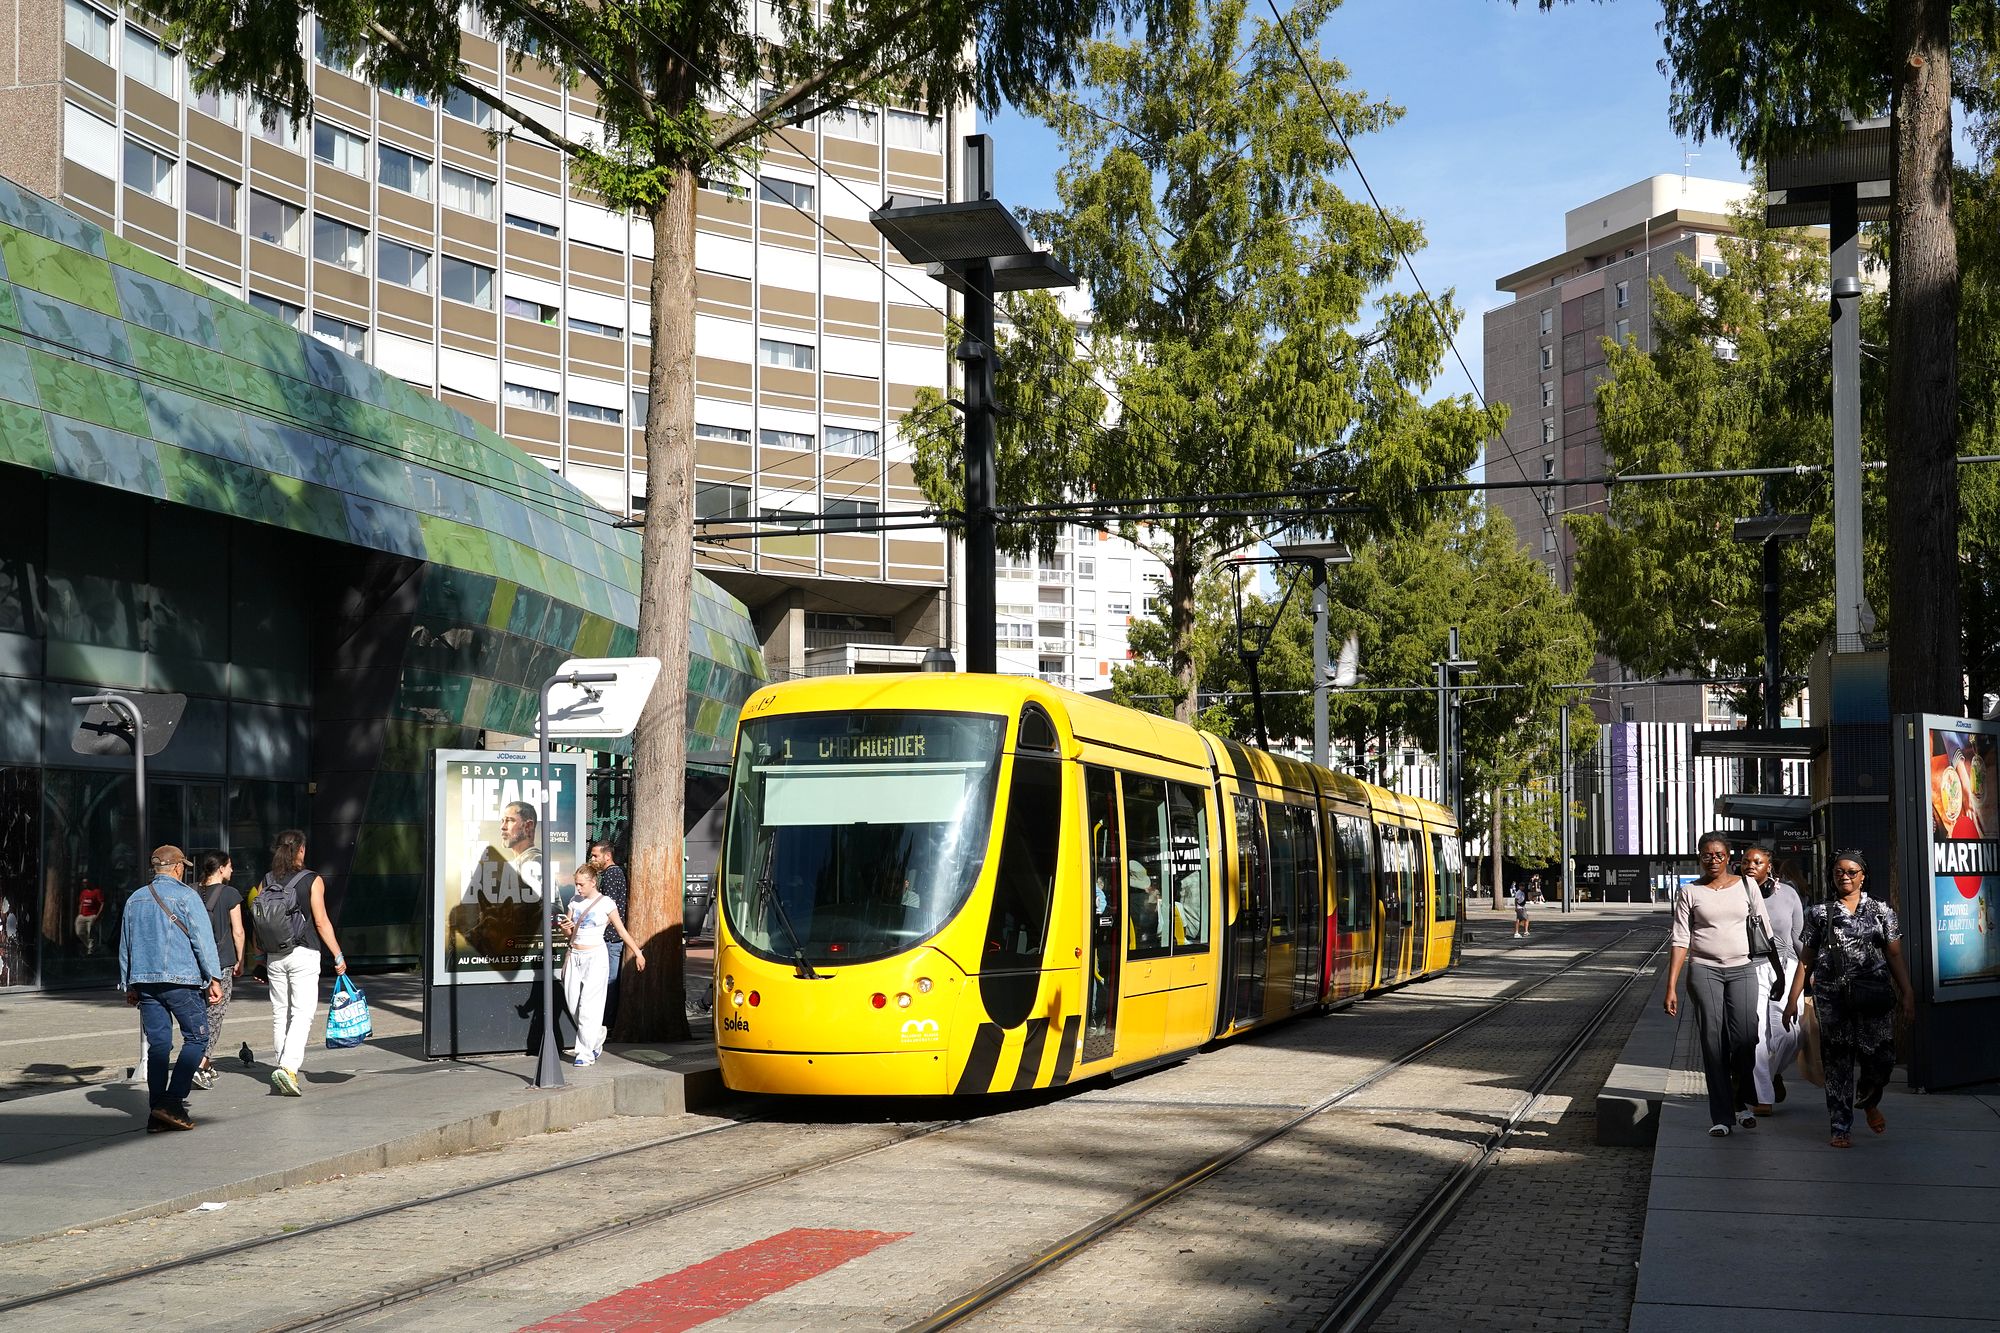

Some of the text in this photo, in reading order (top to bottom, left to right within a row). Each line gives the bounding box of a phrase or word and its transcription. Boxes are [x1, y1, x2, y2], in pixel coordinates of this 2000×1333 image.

[784, 735, 926, 759] 1 CHATAIGNIER
[496, 752, 526, 760] JCDecaux
[462, 765, 562, 777] BRAD PIT
[1616, 728, 1625, 850] CONSERVATOIRE
[1934, 842, 1998, 873] MARTINI
[1943, 901, 1968, 916] DÉCOUVREZ
[1938, 918, 1975, 931] LE MARTINI
[1949, 933, 1964, 945] SPRITZ
[458, 957, 470, 965] AU
[471, 954, 500, 964] CINÉMA
[724, 1011, 750, 1032] Soléa
